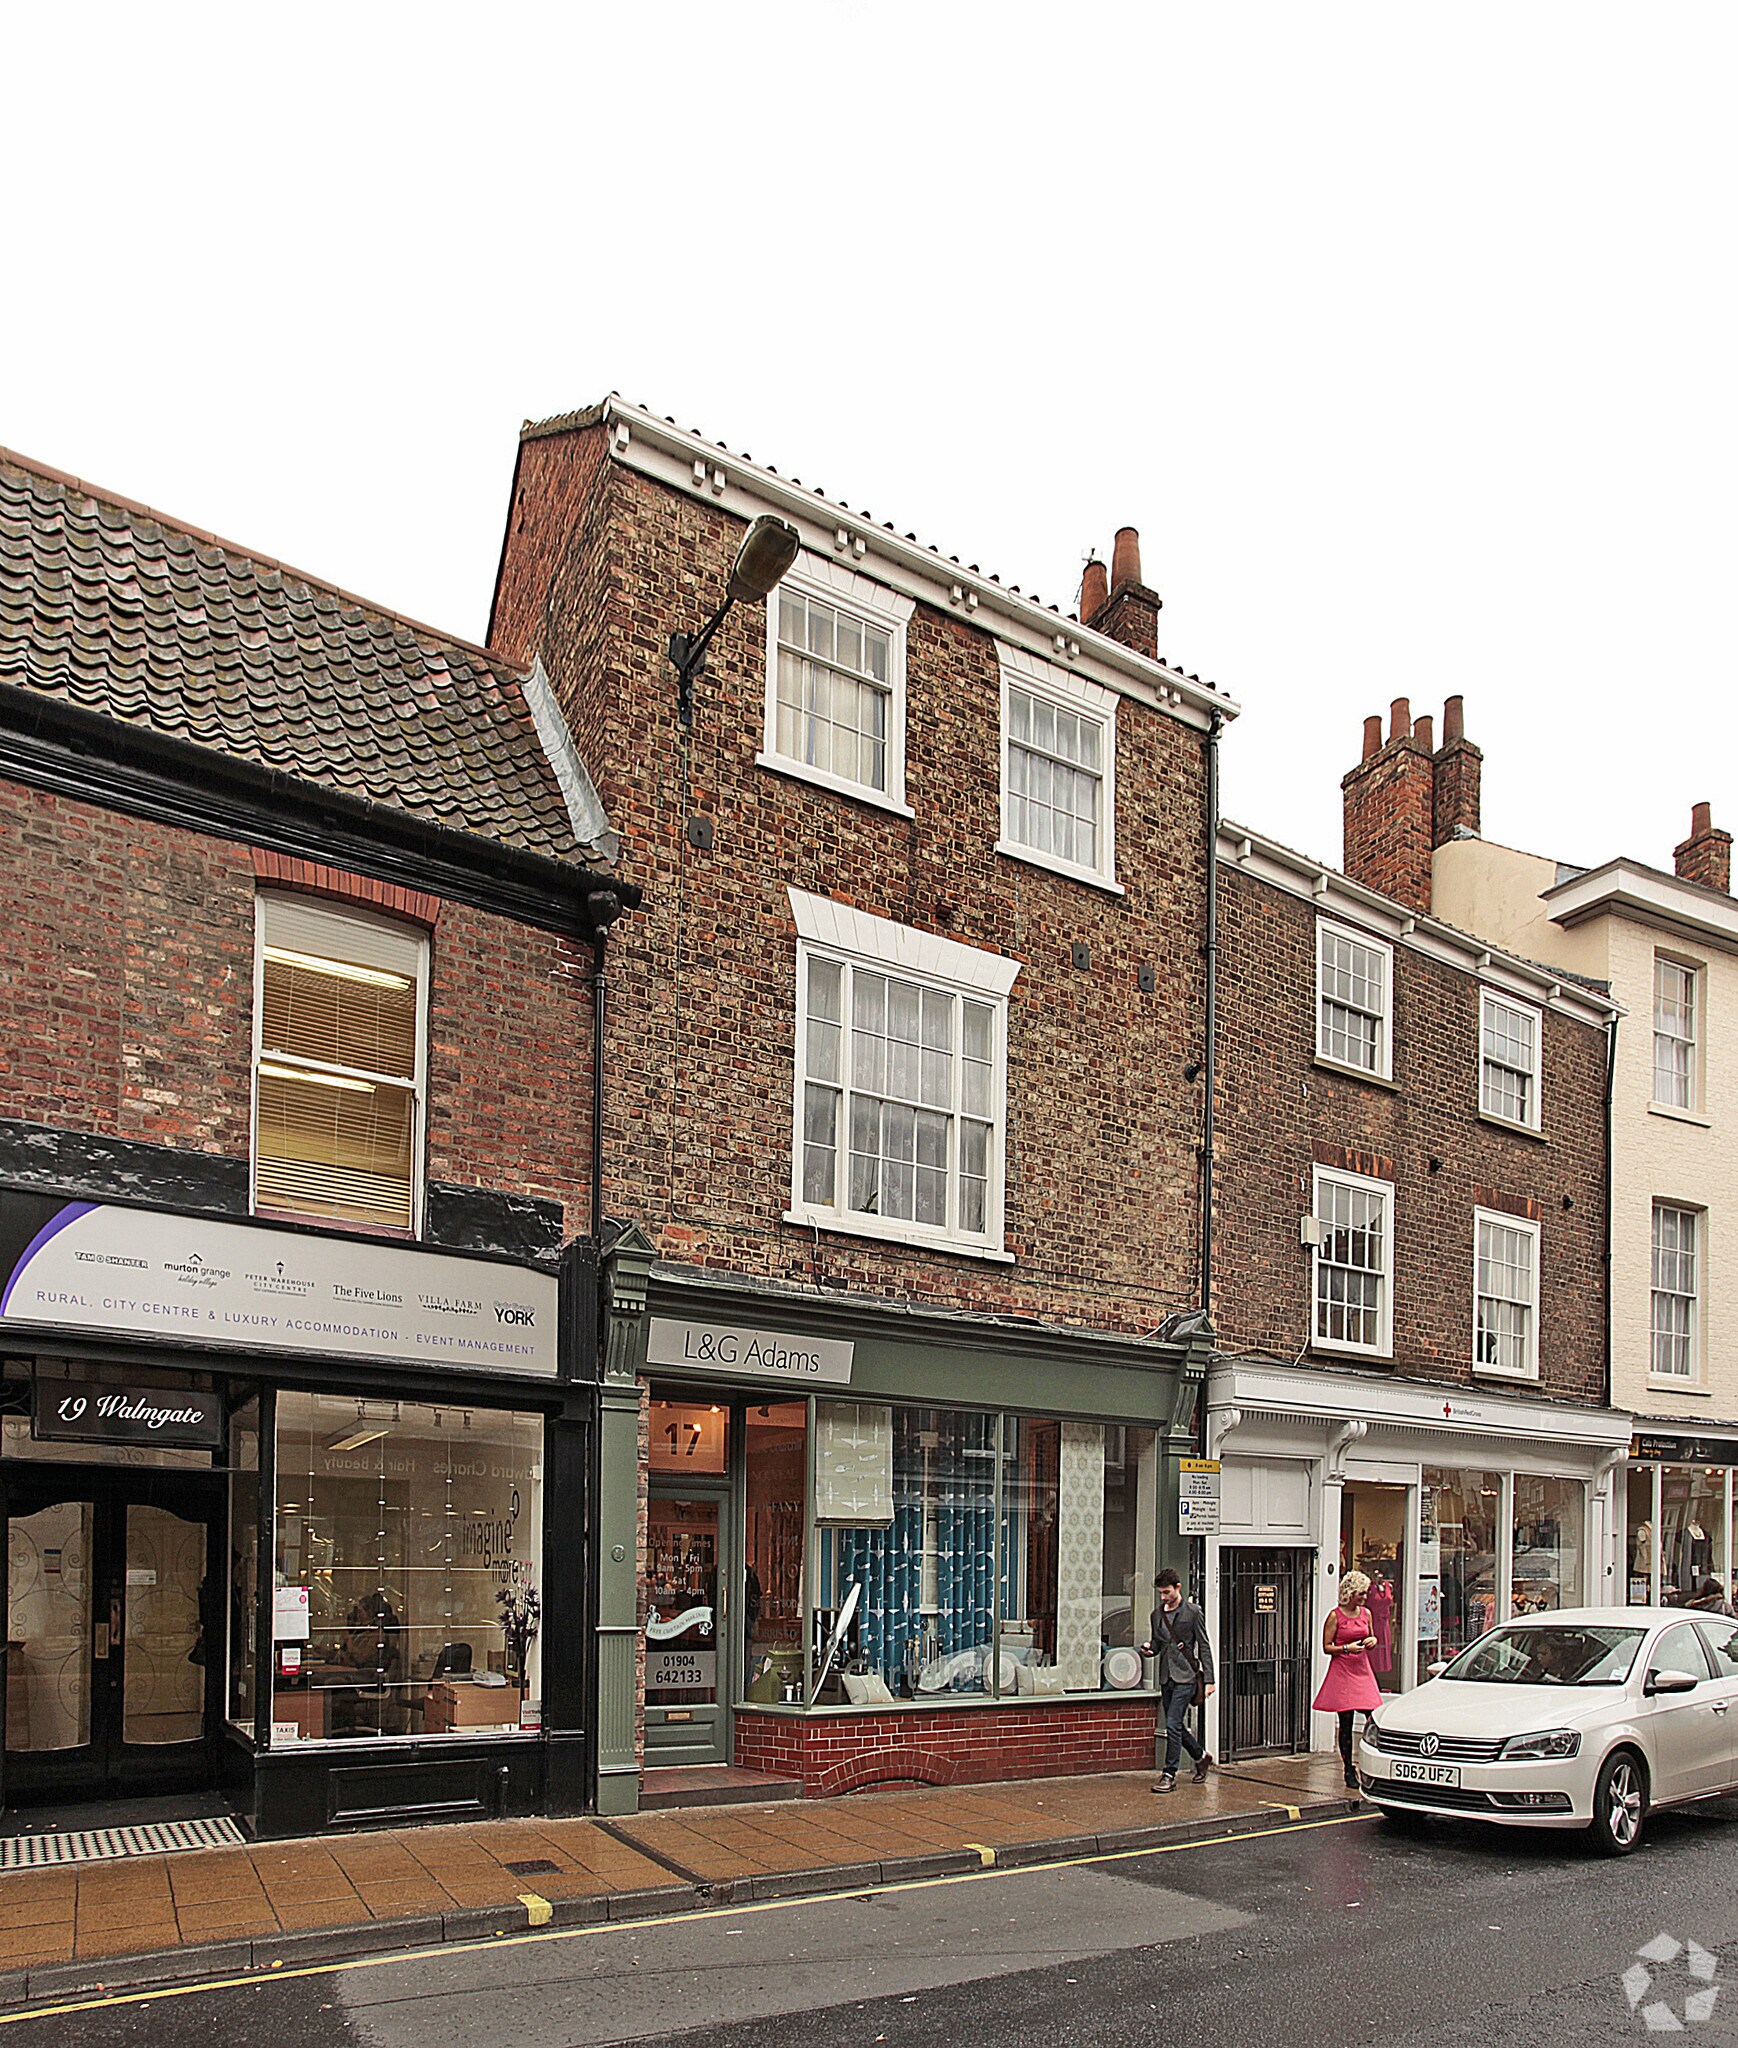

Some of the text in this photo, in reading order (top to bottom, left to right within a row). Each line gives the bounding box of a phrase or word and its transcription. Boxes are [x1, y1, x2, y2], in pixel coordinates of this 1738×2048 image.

[75, 1252, 95, 1262] TAM
[105, 1256, 149, 1269] SHANTER
[164, 1263, 231, 1279] murton grange
[271, 1277, 315, 1288] WAREHOUSE
[275, 1284, 306, 1293] CENTRE
[333, 1285, 351, 1297] The
[354, 1287, 374, 1299] Five
[377, 1290, 403, 1303] Lions
[418, 1294, 450, 1306] VILLA
[455, 1299, 482, 1310] FARM
[494, 1307, 536, 1327] YORK
[103, 1298, 137, 1311] CITY
[142, 1302, 200, 1319] CENTRE
[208, 1310, 216, 1320] &
[225, 1312, 278, 1327] LUXURY
[286, 1318, 398, 1340] ACCOMMODATION
[416, 1333, 454, 1346] EVENT
[458, 1338, 536, 1355] MANAGEMENT
[684, 1330, 820, 1372] L&G Adams
[57, 1395, 205, 1429] 19 Walmgate
[664, 1422, 702, 1457] 17
[660, 1553, 700, 1562] Mon Fri
[656, 1563, 675, 1573] 9am
[685, 1565, 703, 1575] 5pm
[673, 1576, 686, 1585] Sat
[655, 1586, 676, 1595] 10am
[686, 1587, 705, 1597] 4pm
[656, 1655, 702, 1684] 01904 642133
[1395, 1763, 1454, 1783] SD62 UFZ
